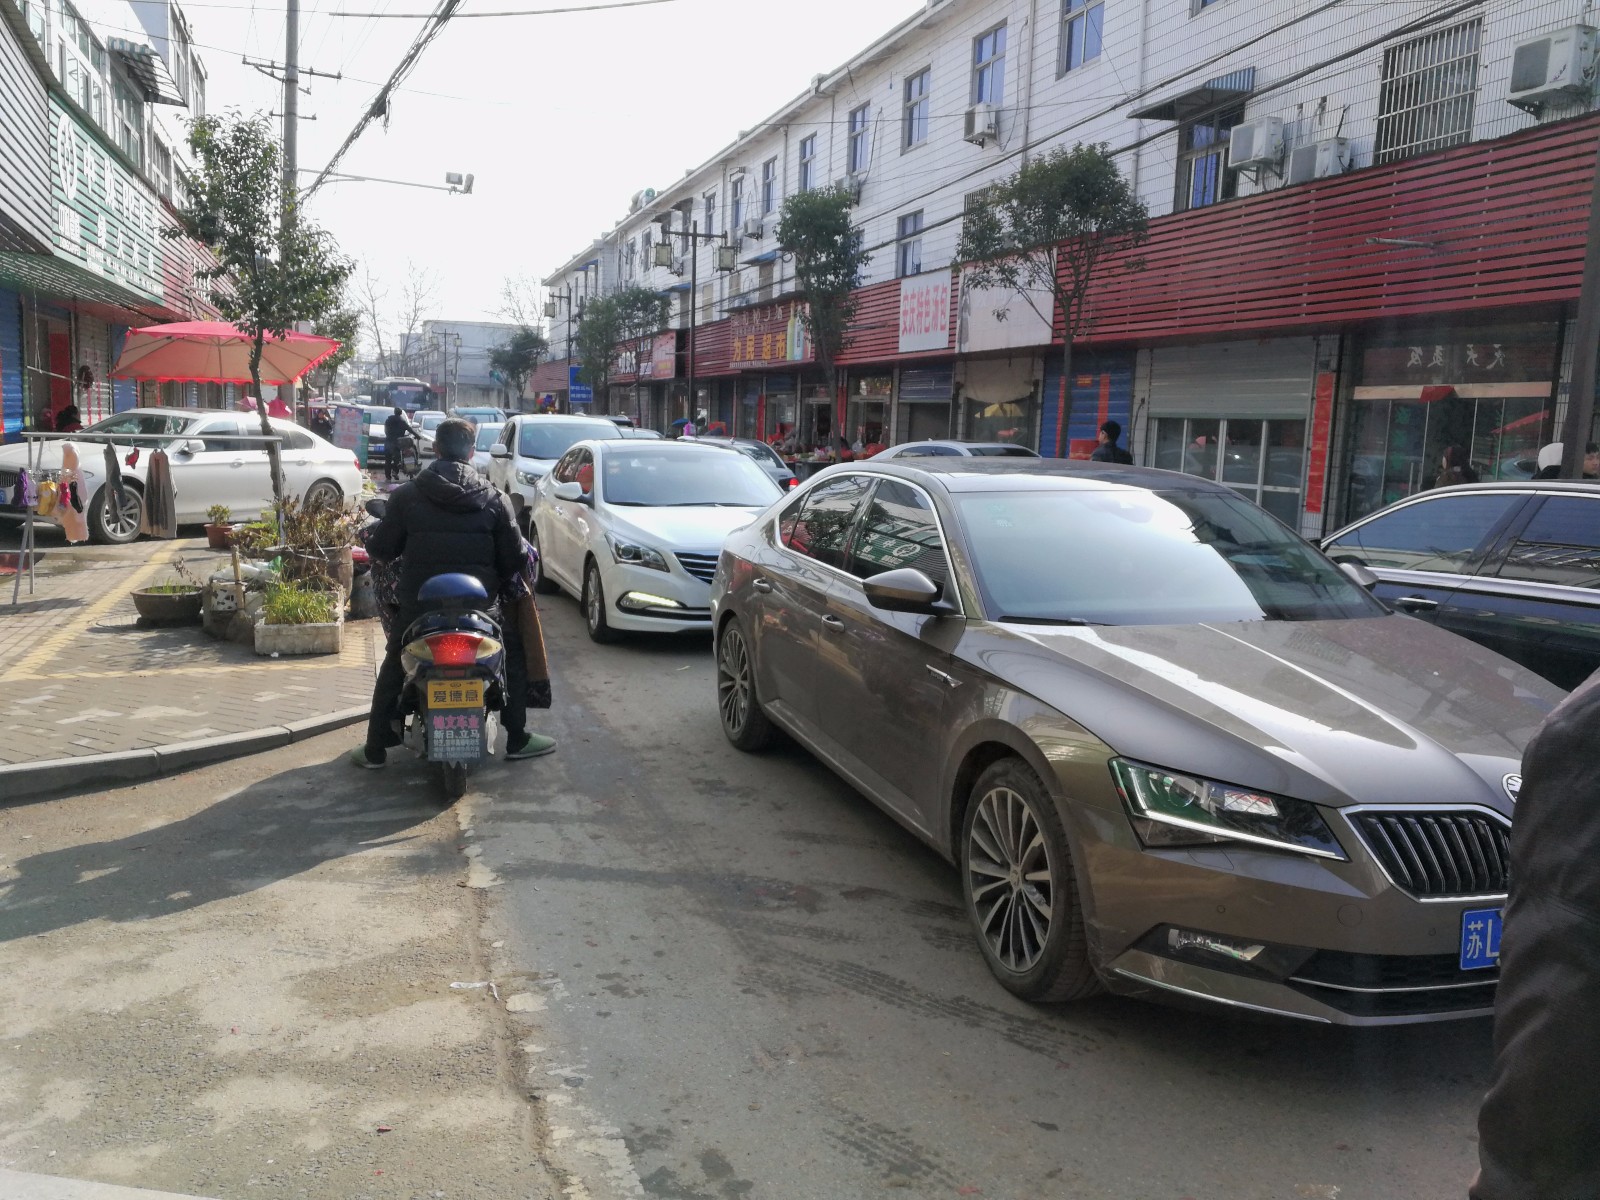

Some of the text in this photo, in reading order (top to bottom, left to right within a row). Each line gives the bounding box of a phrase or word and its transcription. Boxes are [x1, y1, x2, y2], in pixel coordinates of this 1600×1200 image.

[902, 282, 948, 337] 安庆特色汤包
[733, 331, 786, 362] 为民超市
[1466, 919, 1500, 960] 苏L
